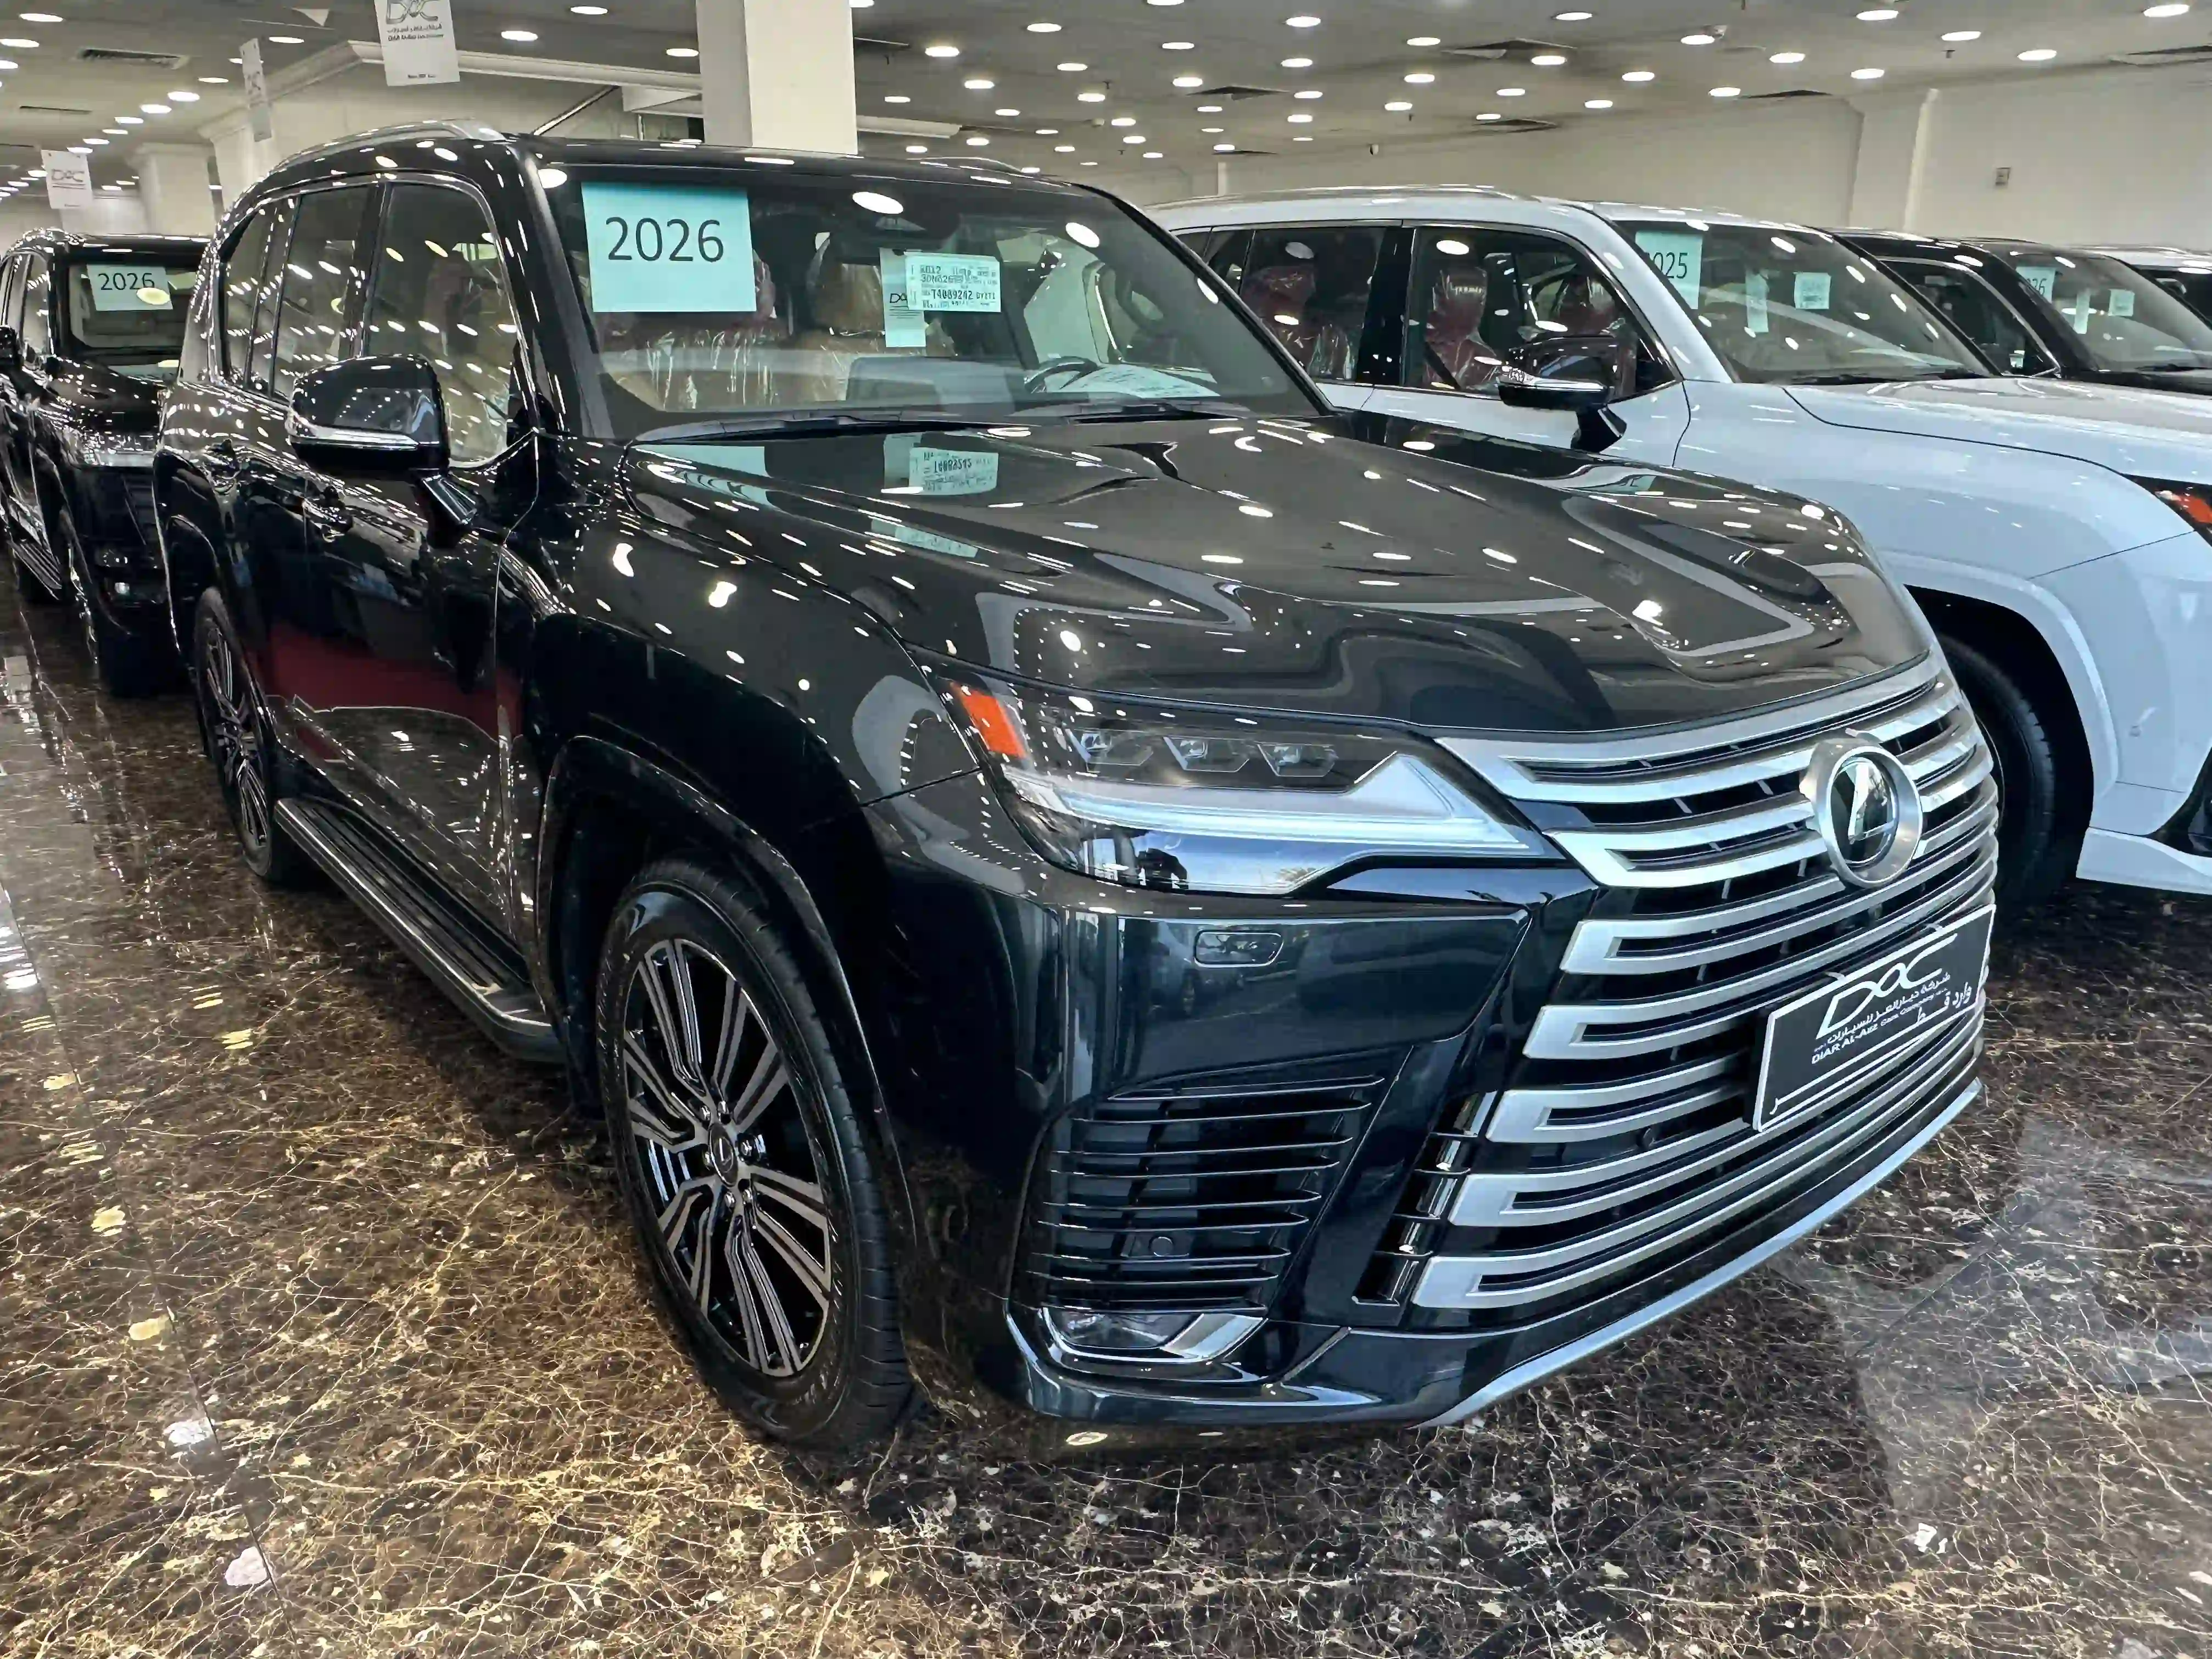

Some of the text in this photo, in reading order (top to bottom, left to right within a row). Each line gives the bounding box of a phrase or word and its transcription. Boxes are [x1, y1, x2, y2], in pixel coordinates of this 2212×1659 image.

[606, 216, 724, 262] 2026
[1647, 252, 1688, 279] 025
[98, 272, 155, 291] 2026
